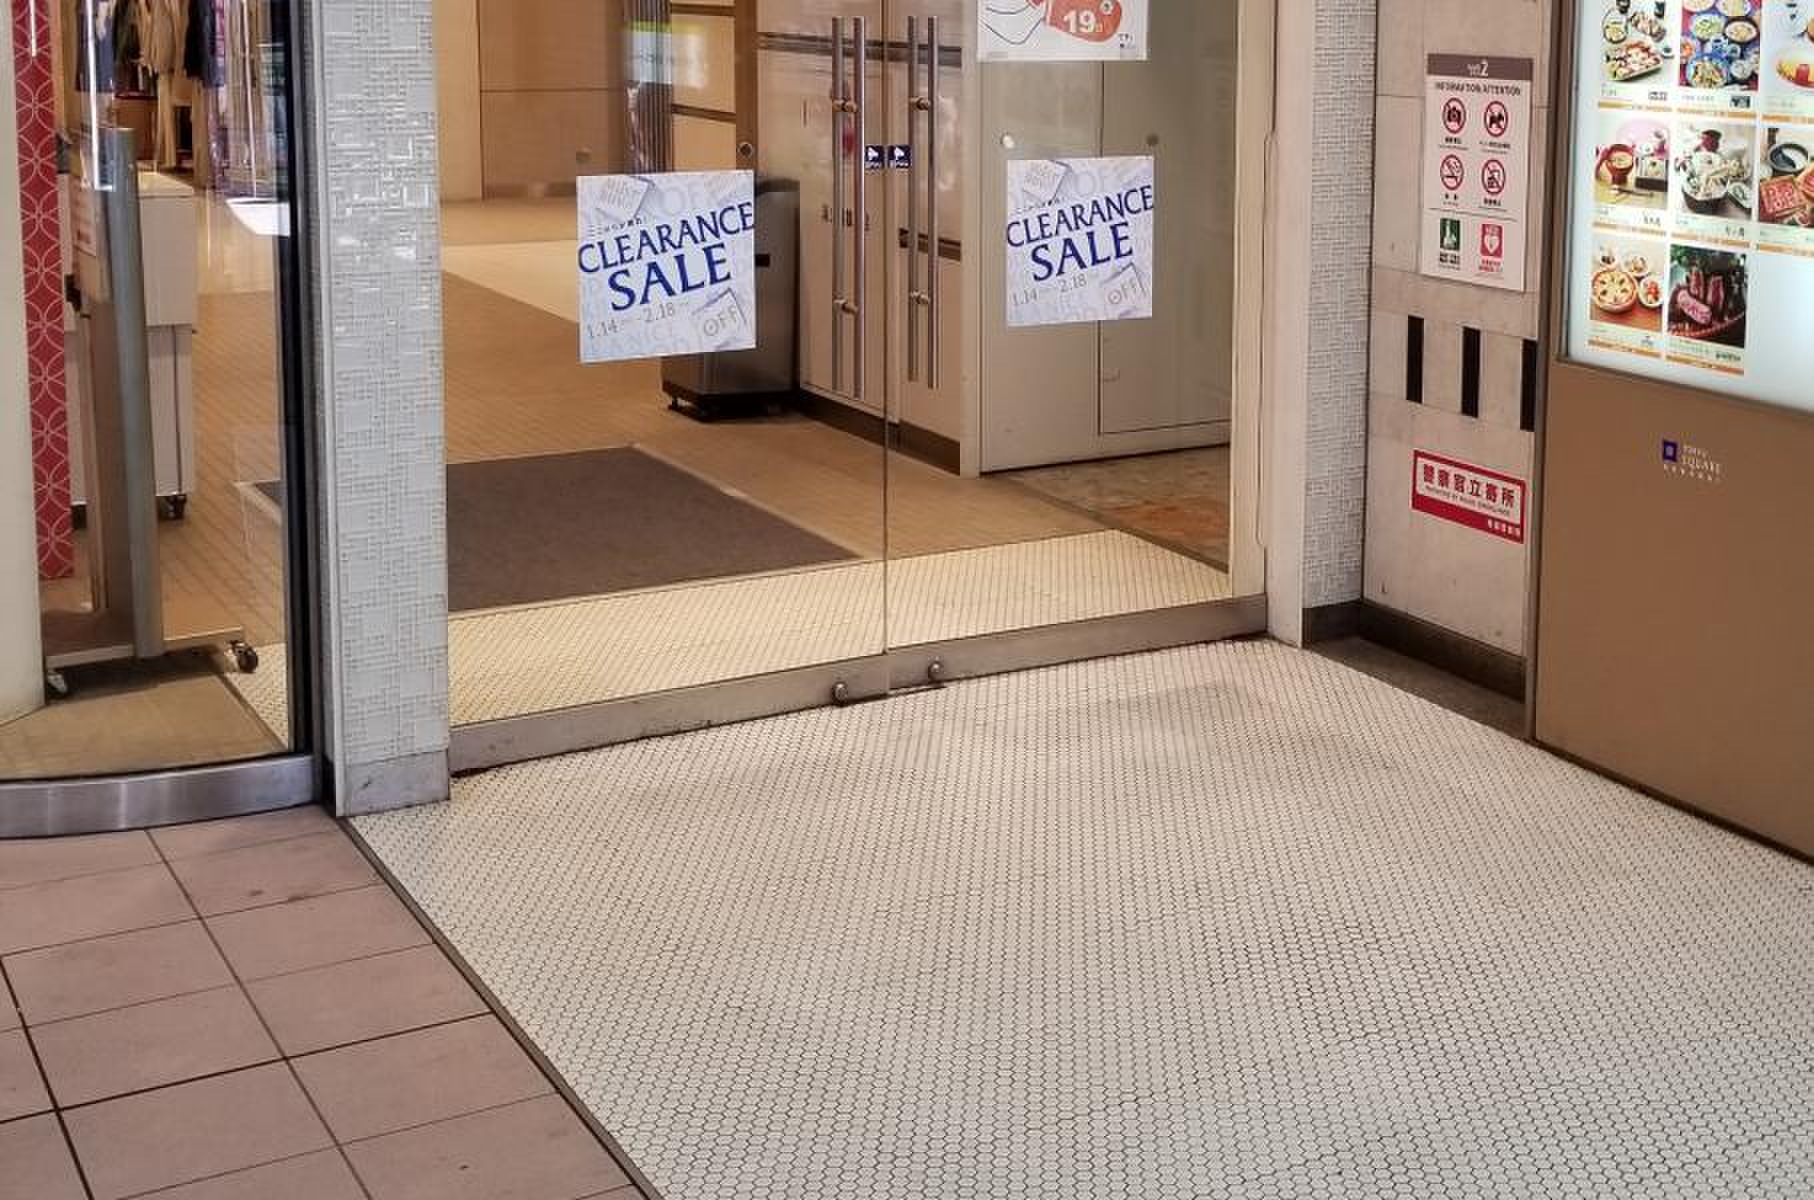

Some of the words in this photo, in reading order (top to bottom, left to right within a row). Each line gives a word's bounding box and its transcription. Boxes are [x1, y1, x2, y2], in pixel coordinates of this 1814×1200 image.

[578, 202, 756, 274] CLEARANCE
[1007, 185, 1155, 248] CLEARANCE
[608, 243, 732, 311] SALE
[1031, 222, 1134, 282] SALE
